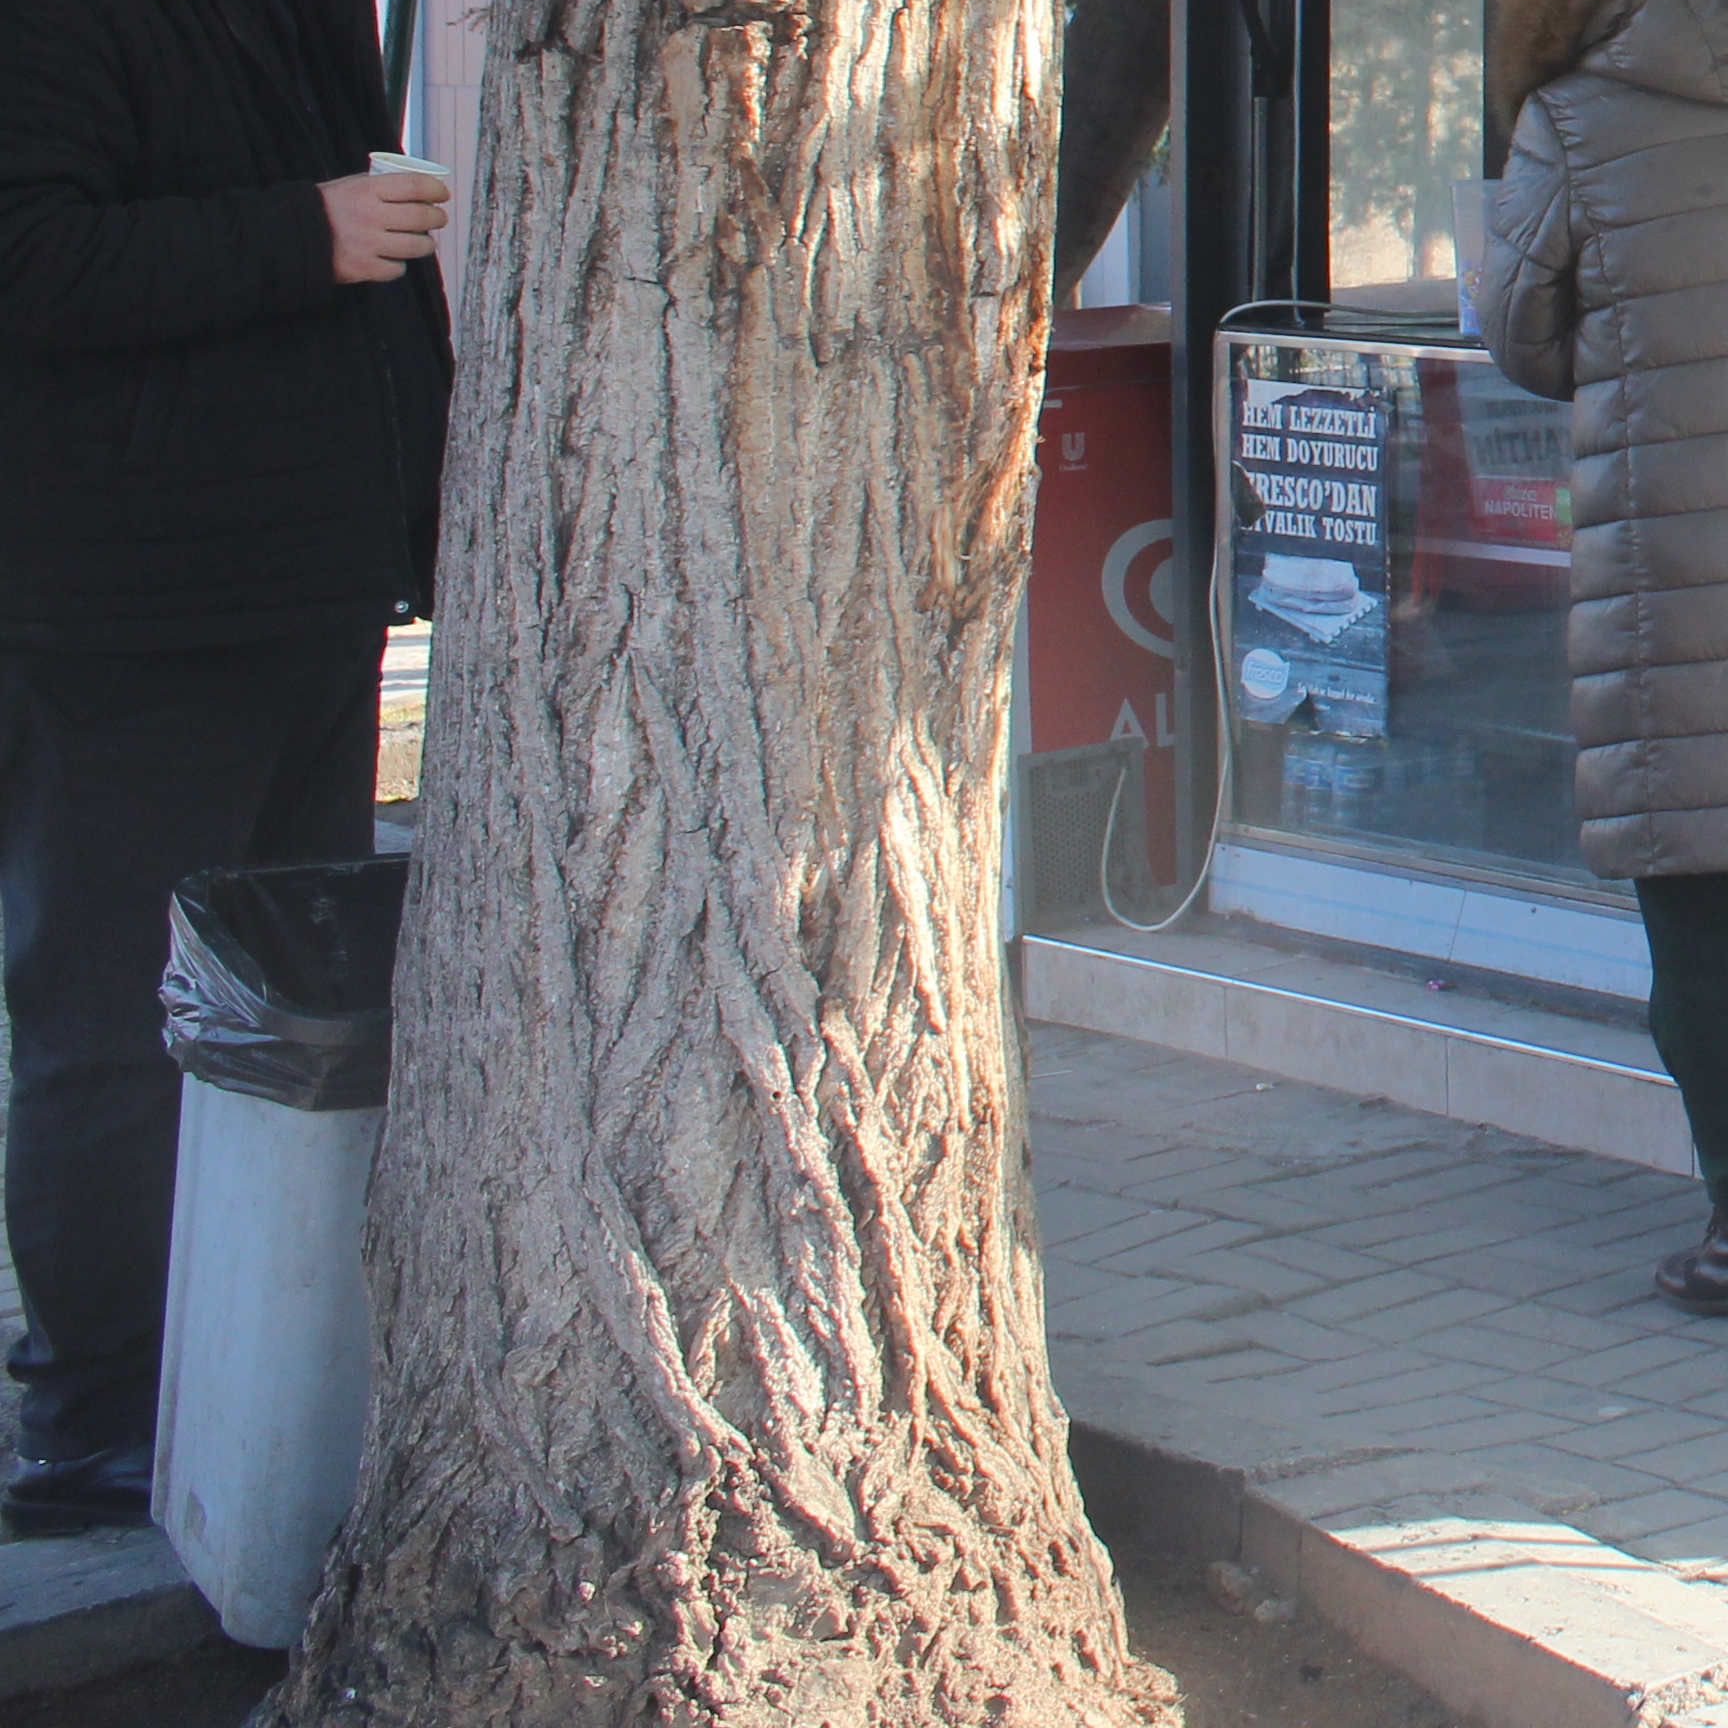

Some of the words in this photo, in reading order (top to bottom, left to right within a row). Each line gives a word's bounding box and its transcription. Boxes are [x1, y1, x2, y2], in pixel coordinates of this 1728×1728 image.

[1242, 402, 1283, 430] HEM
[1289, 406, 1377, 439] LEZZETLİ
[1241, 433, 1282, 462] HEM
[1286, 437, 1379, 472] DOYURUCU
[1240, 509, 1317, 538] VALIK
[1322, 516, 1377, 546] TOSTU
